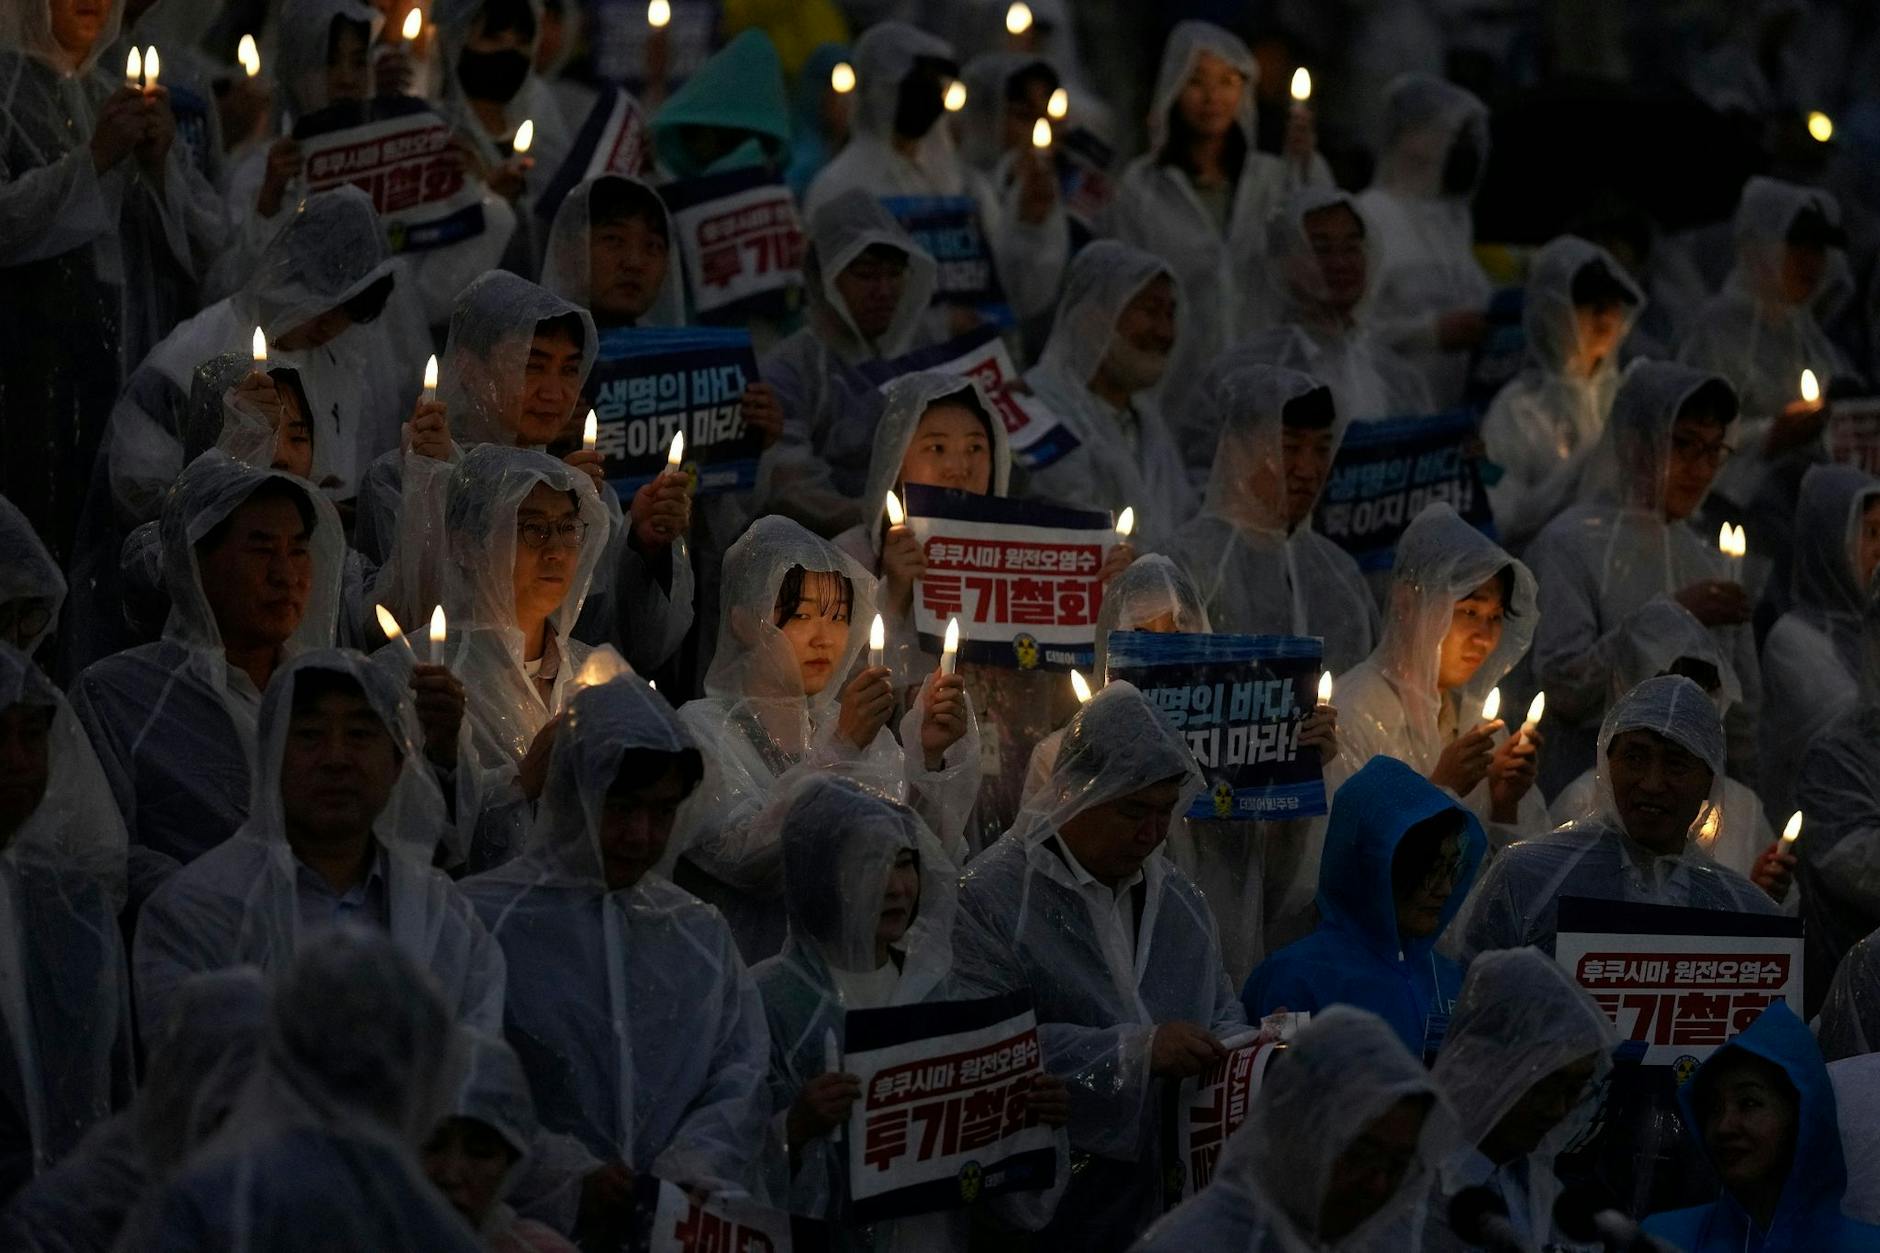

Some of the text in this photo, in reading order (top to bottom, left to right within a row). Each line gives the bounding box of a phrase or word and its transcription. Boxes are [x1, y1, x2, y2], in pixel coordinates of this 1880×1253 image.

[595, 370, 688, 420] 생명의
[598, 403, 747, 462] 죽이지 마라
[928, 542, 1096, 572] 후쿠시마 원전오염수
[922, 575, 1103, 625] 투기철회
[1227, 720, 1302, 766] 마라!
[1582, 959, 1782, 984] 후쿠시마 원전오염수
[873, 1037, 1039, 1103] 후쿠시마 원전오염수
